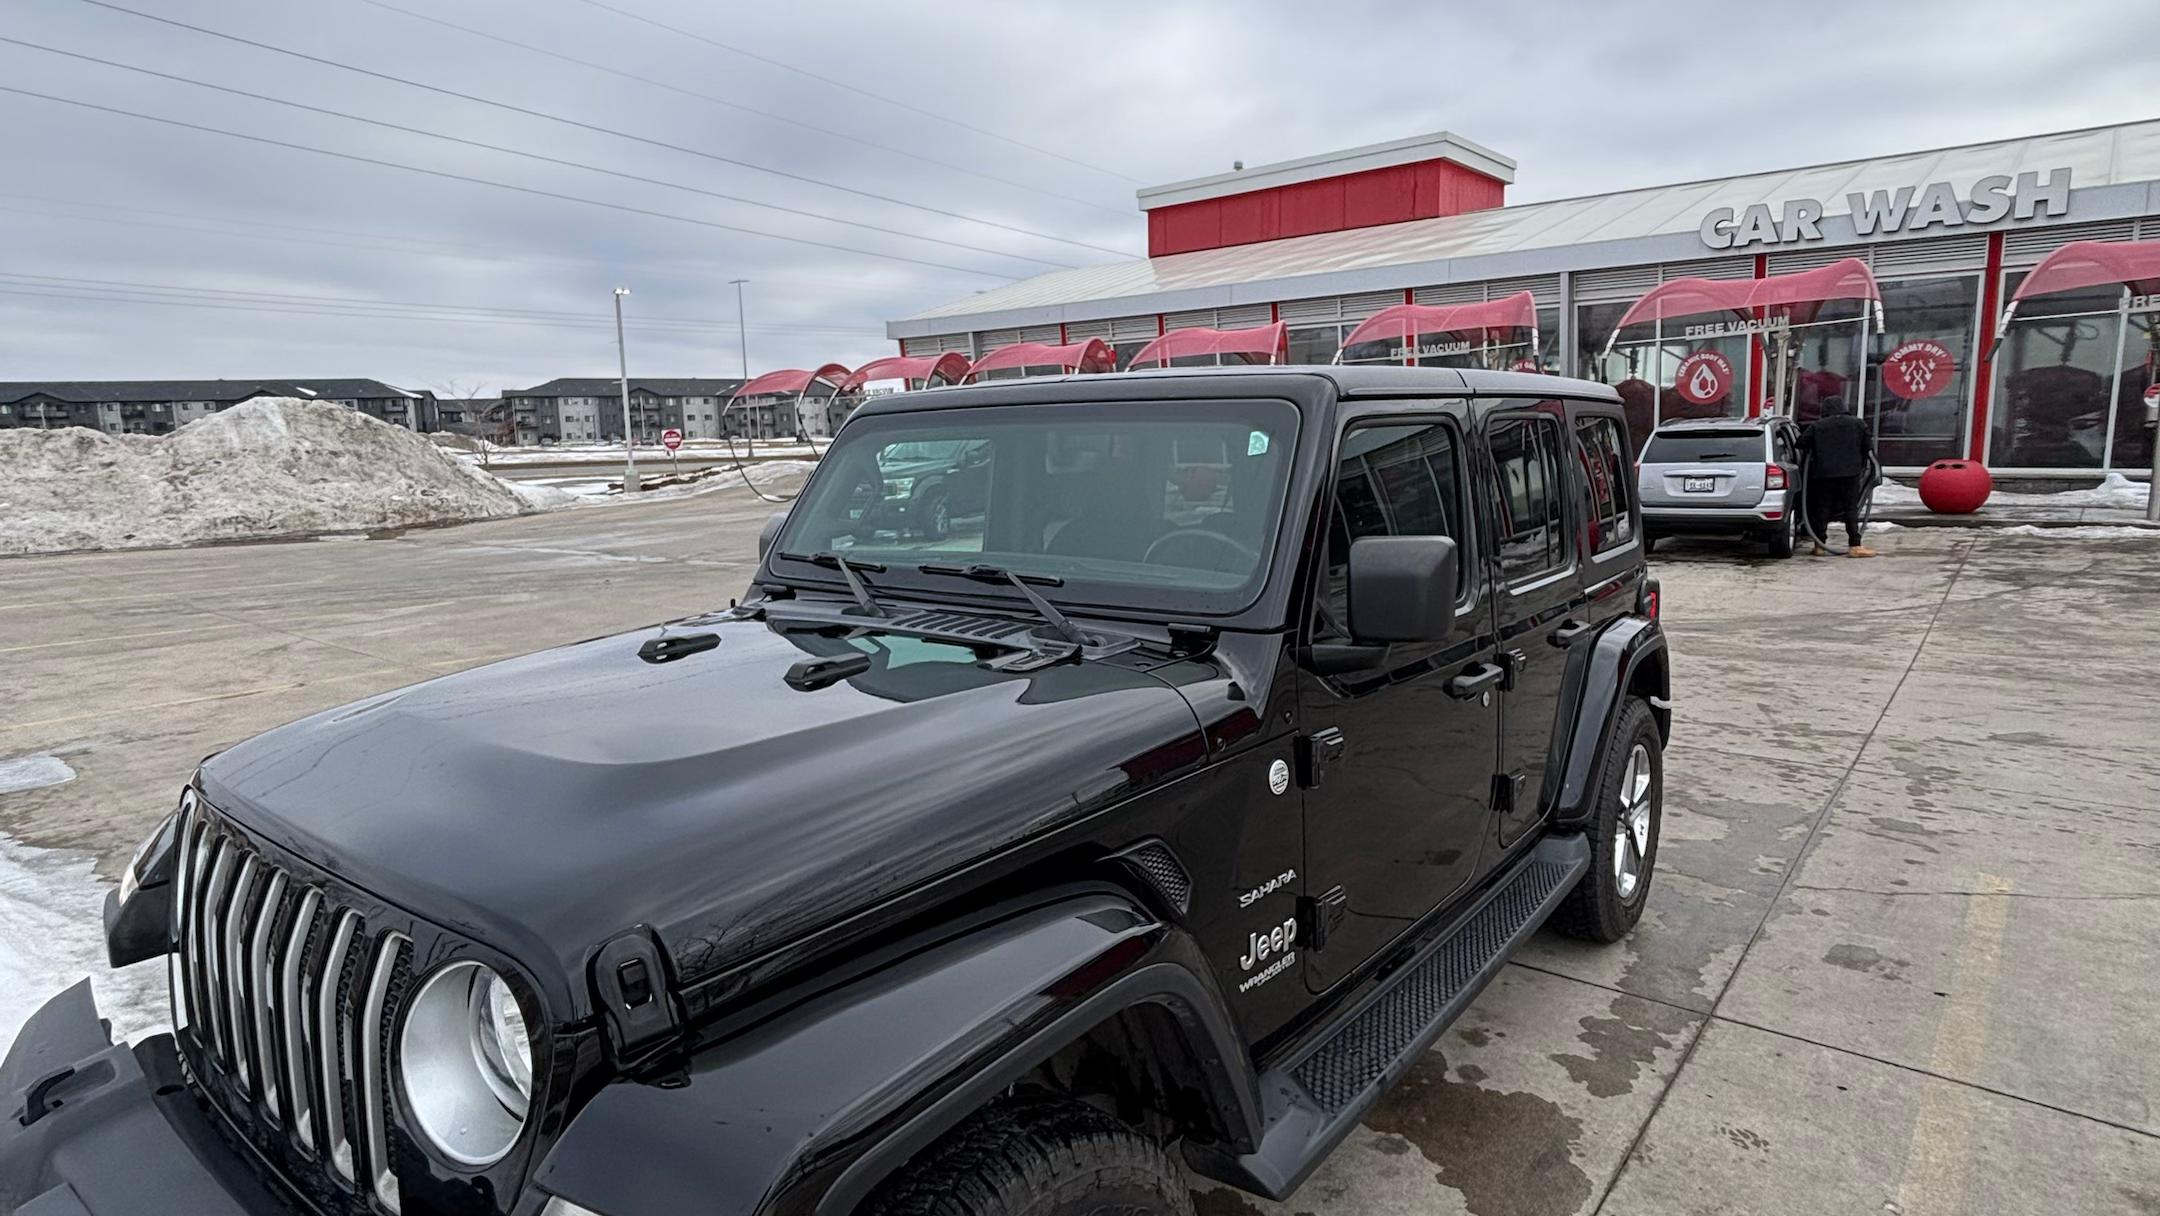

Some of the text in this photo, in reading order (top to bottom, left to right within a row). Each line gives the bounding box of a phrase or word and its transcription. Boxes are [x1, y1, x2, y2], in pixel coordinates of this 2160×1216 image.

[1700, 167, 2072, 250] CAR WASH
[2119, 294, 2160, 314] FRE
[1685, 315, 1789, 339] FREE VACUUM
[1422, 341, 1470, 356] VACUUM
[1890, 343, 1945, 362] TOMMY DRY
[1239, 869, 1297, 908] SAHARA
[1240, 918, 1297, 971] Jeep
[1239, 951, 1295, 993] WRANGLER
